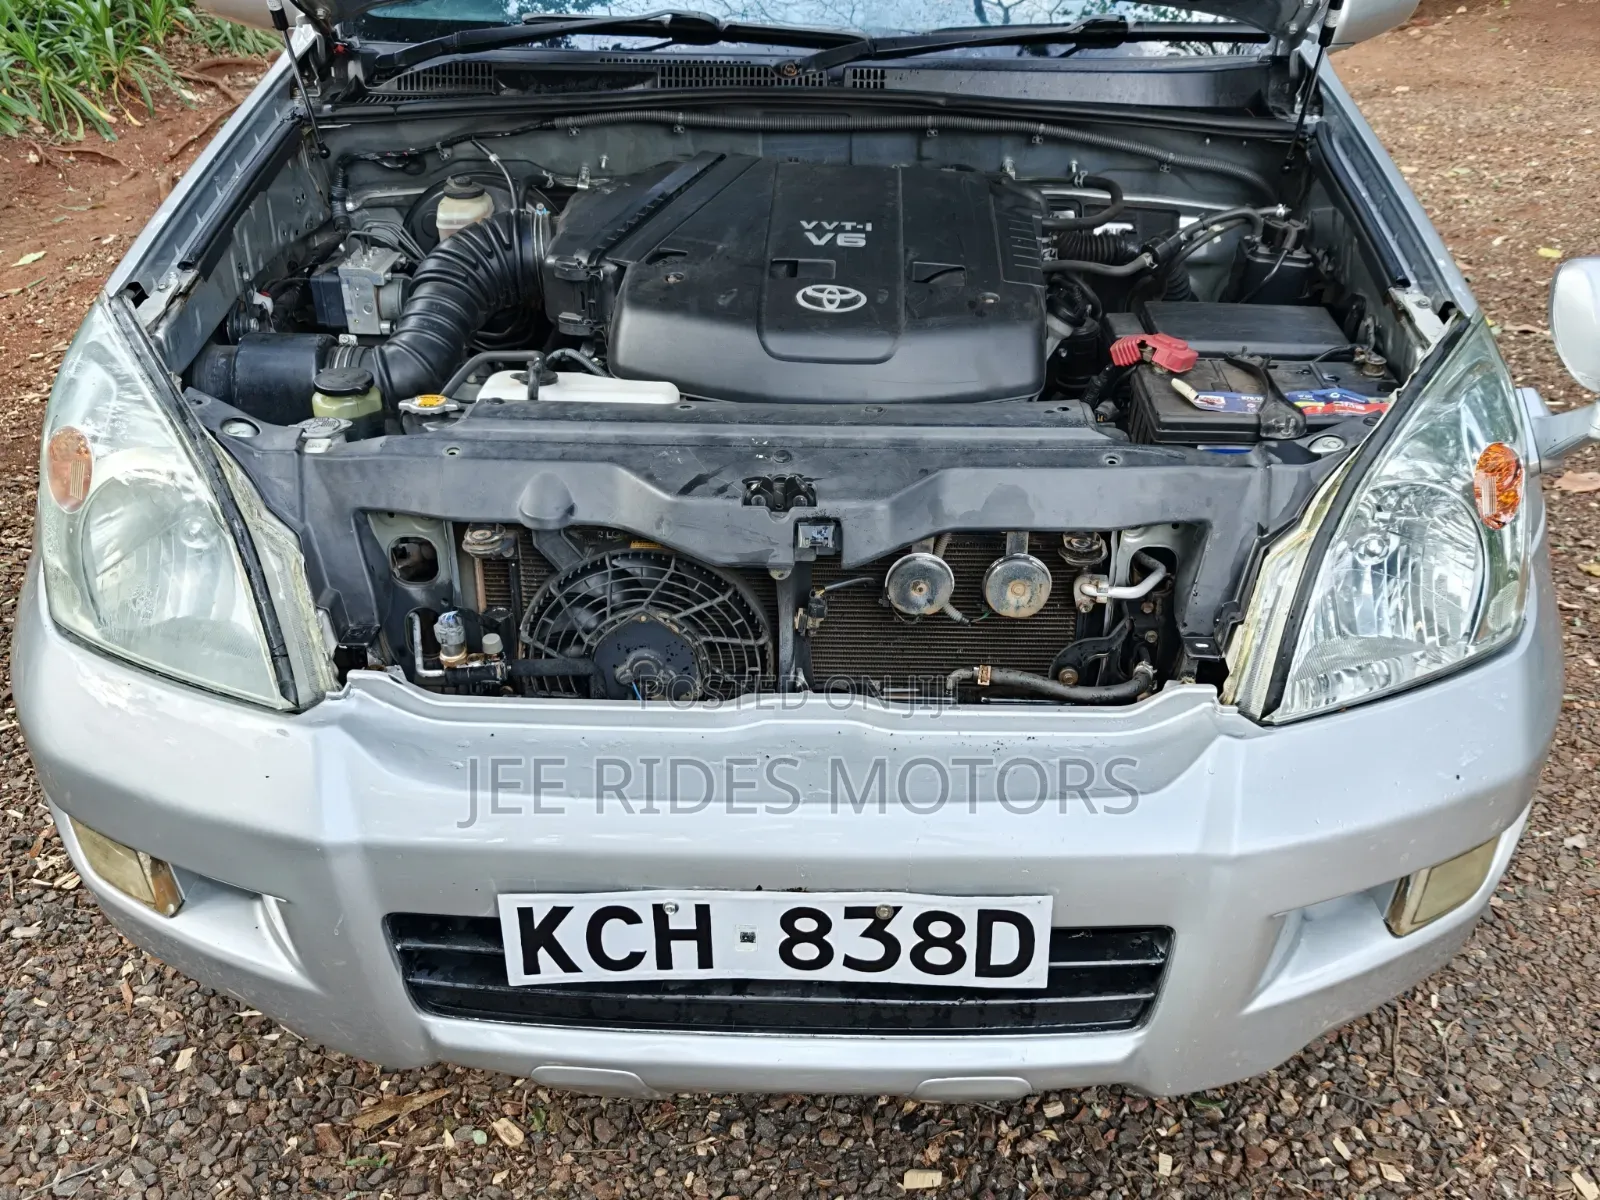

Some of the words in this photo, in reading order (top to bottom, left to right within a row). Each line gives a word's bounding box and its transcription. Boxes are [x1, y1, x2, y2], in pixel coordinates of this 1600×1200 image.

[803, 231, 867, 248] V6
[516, 903, 715, 976] KCH
[777, 904, 1036, 979] 838D
